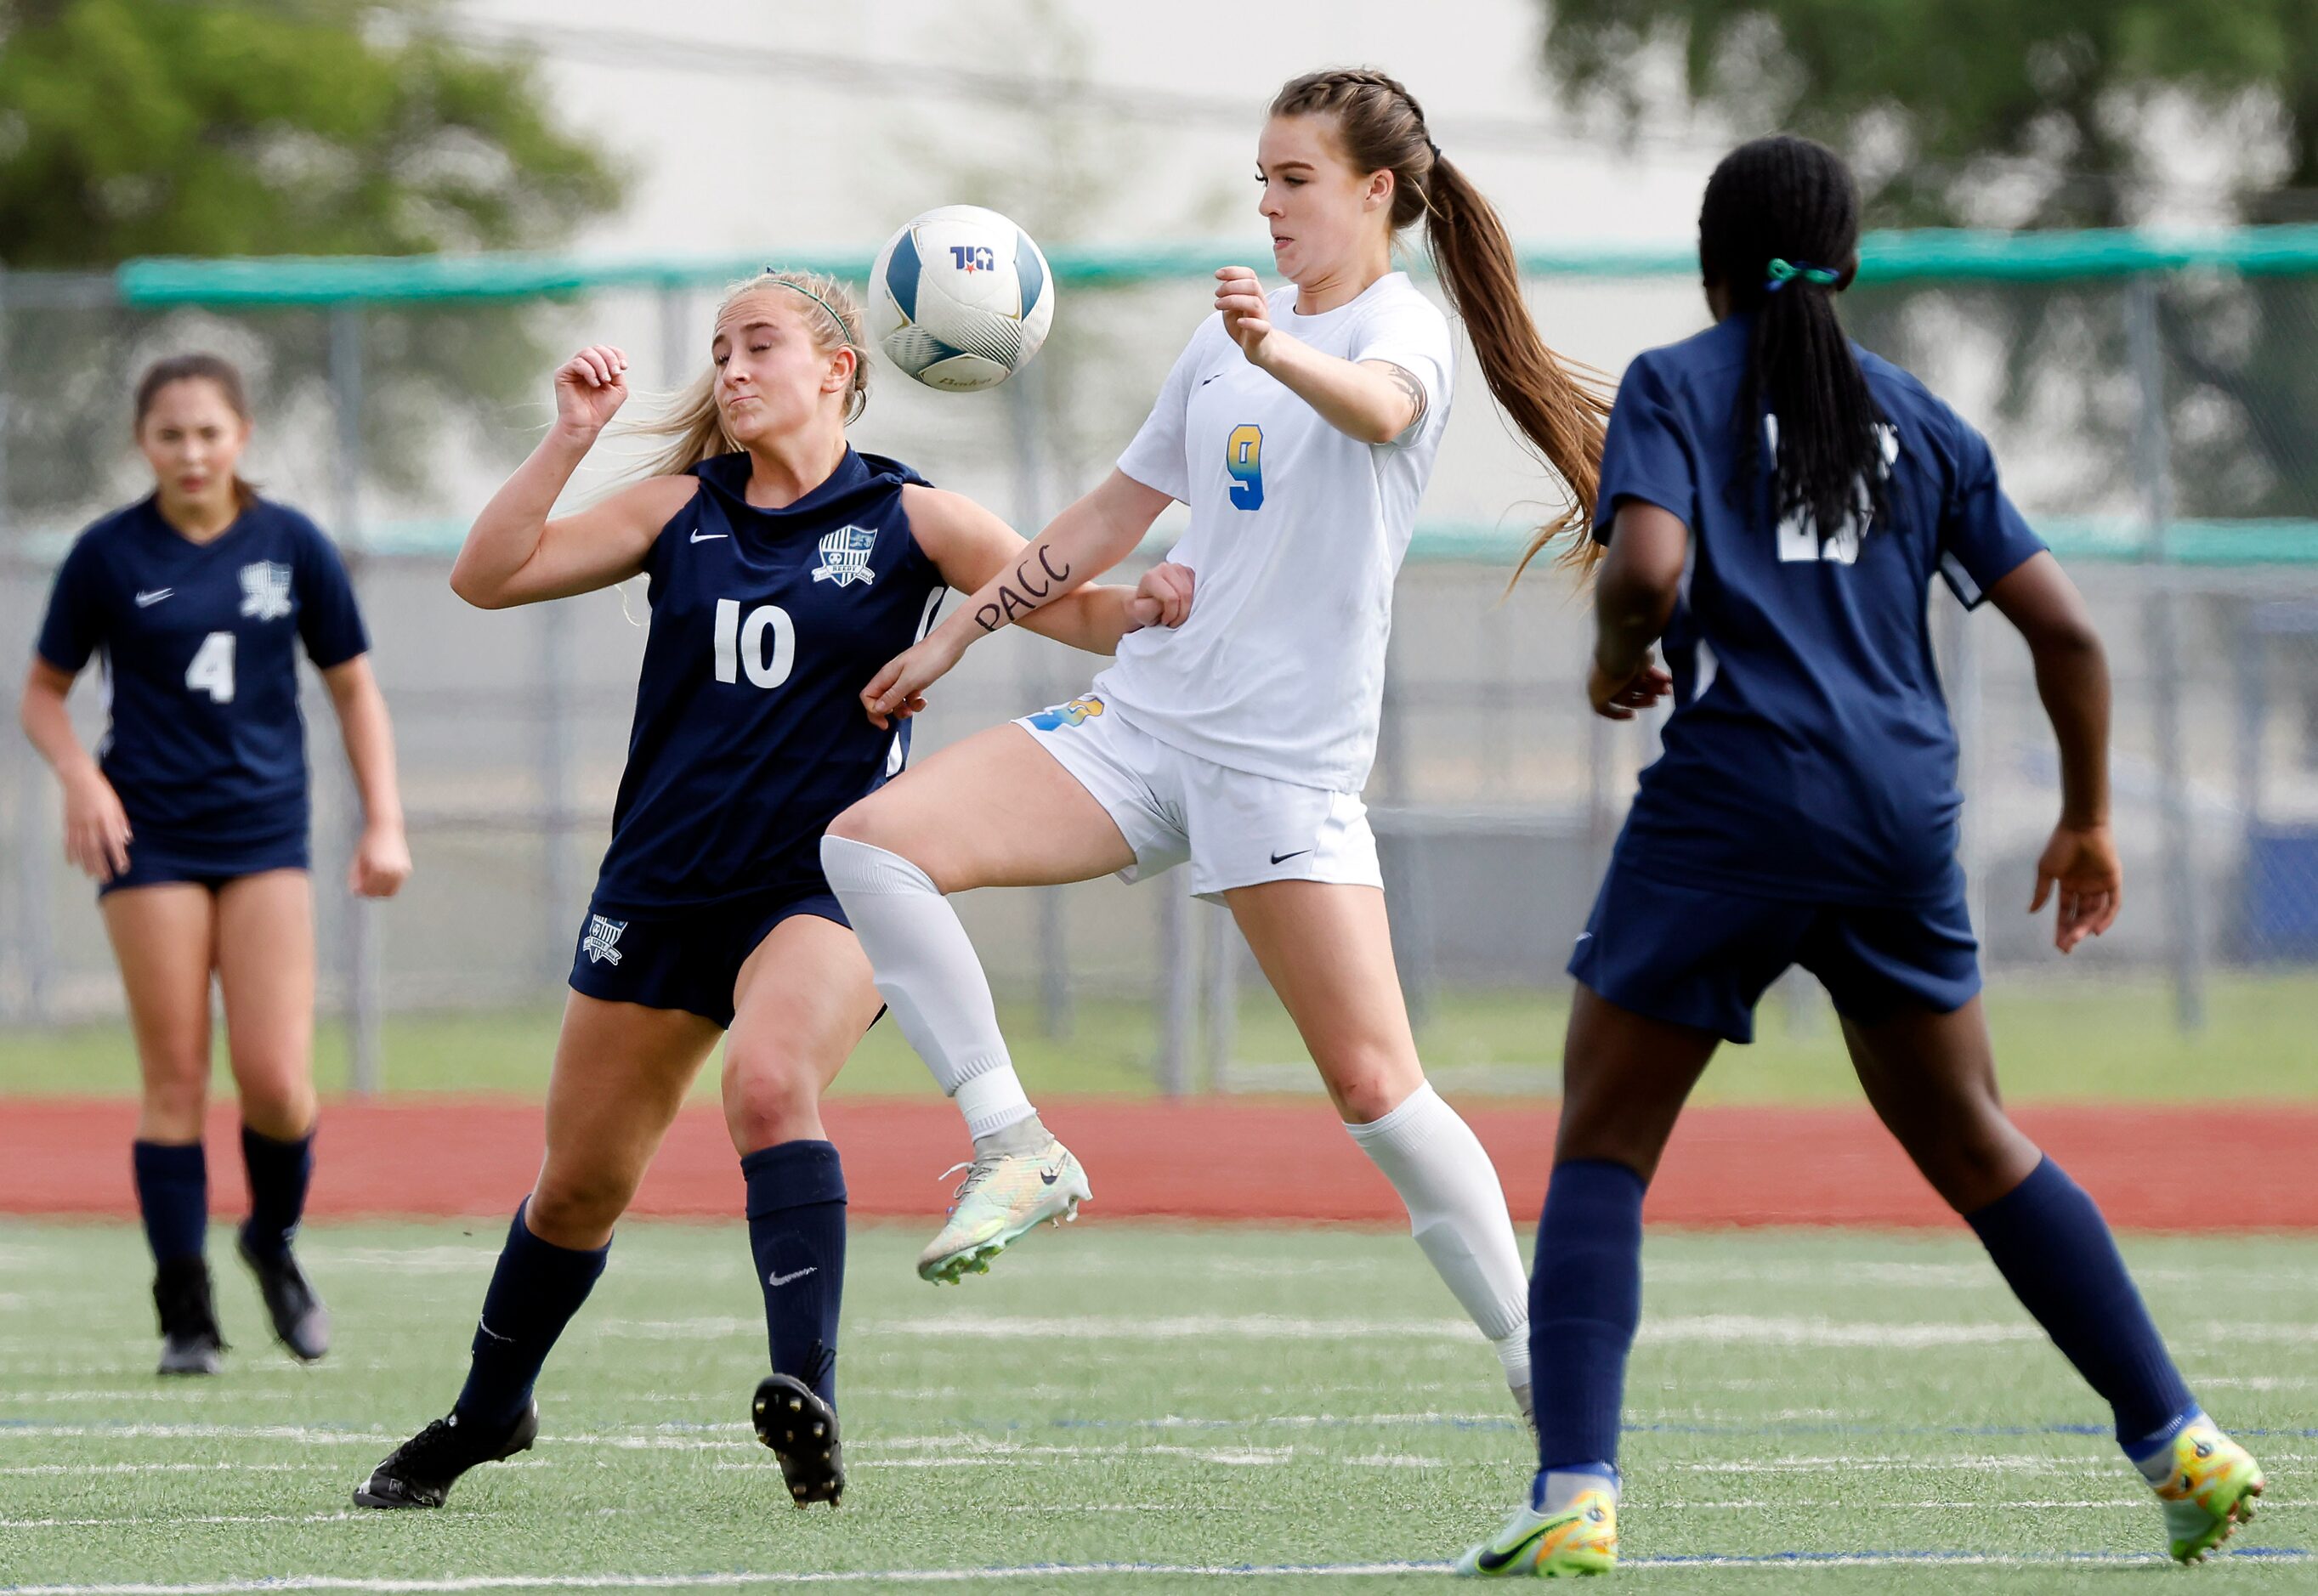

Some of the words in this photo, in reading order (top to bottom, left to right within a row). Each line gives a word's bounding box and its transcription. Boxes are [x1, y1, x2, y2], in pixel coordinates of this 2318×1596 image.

[950, 246, 995, 271] UIL
[1227, 424, 1264, 511] 9
[974, 545, 1070, 632] PACC
[184, 631, 236, 704] 4
[714, 598, 796, 689] 10
